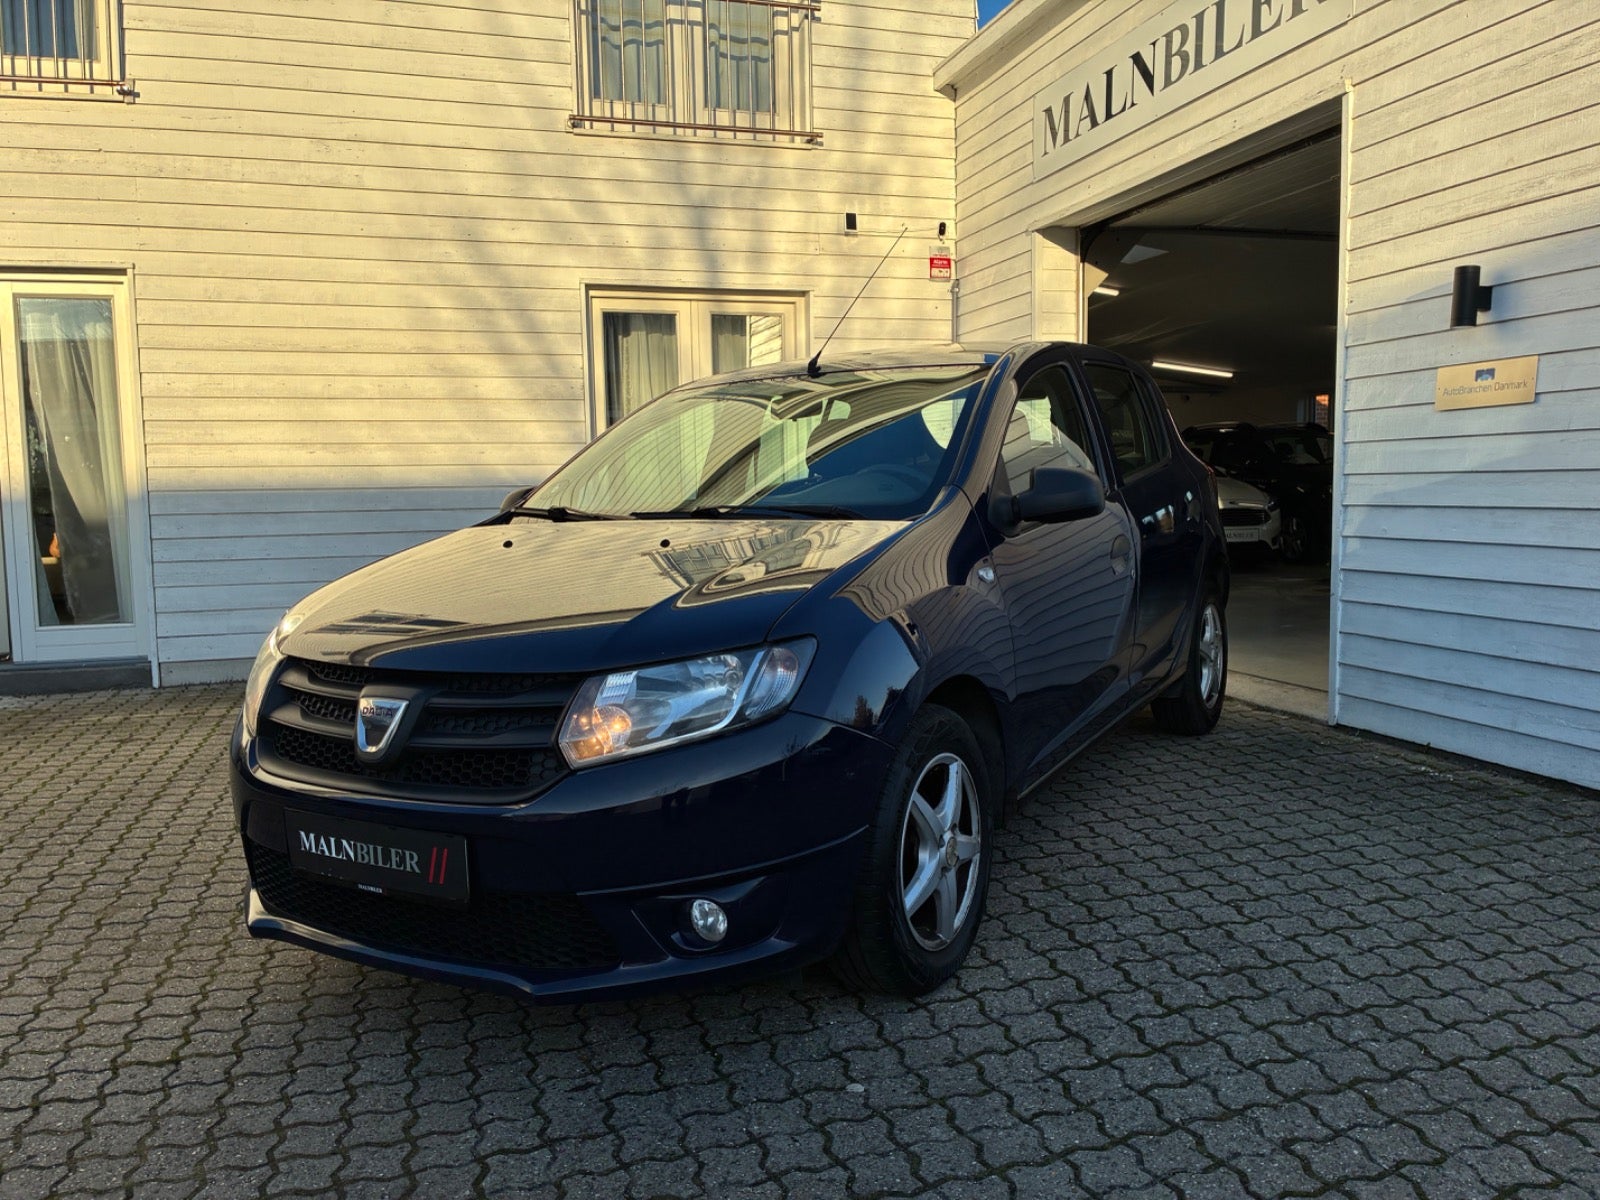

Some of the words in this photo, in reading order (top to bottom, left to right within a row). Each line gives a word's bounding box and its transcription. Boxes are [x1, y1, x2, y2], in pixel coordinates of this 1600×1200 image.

[1442, 384, 1492, 397] AutoBranchen
[1493, 380, 1528, 392] Danmark
[298, 830, 421, 873] MALNBILER
